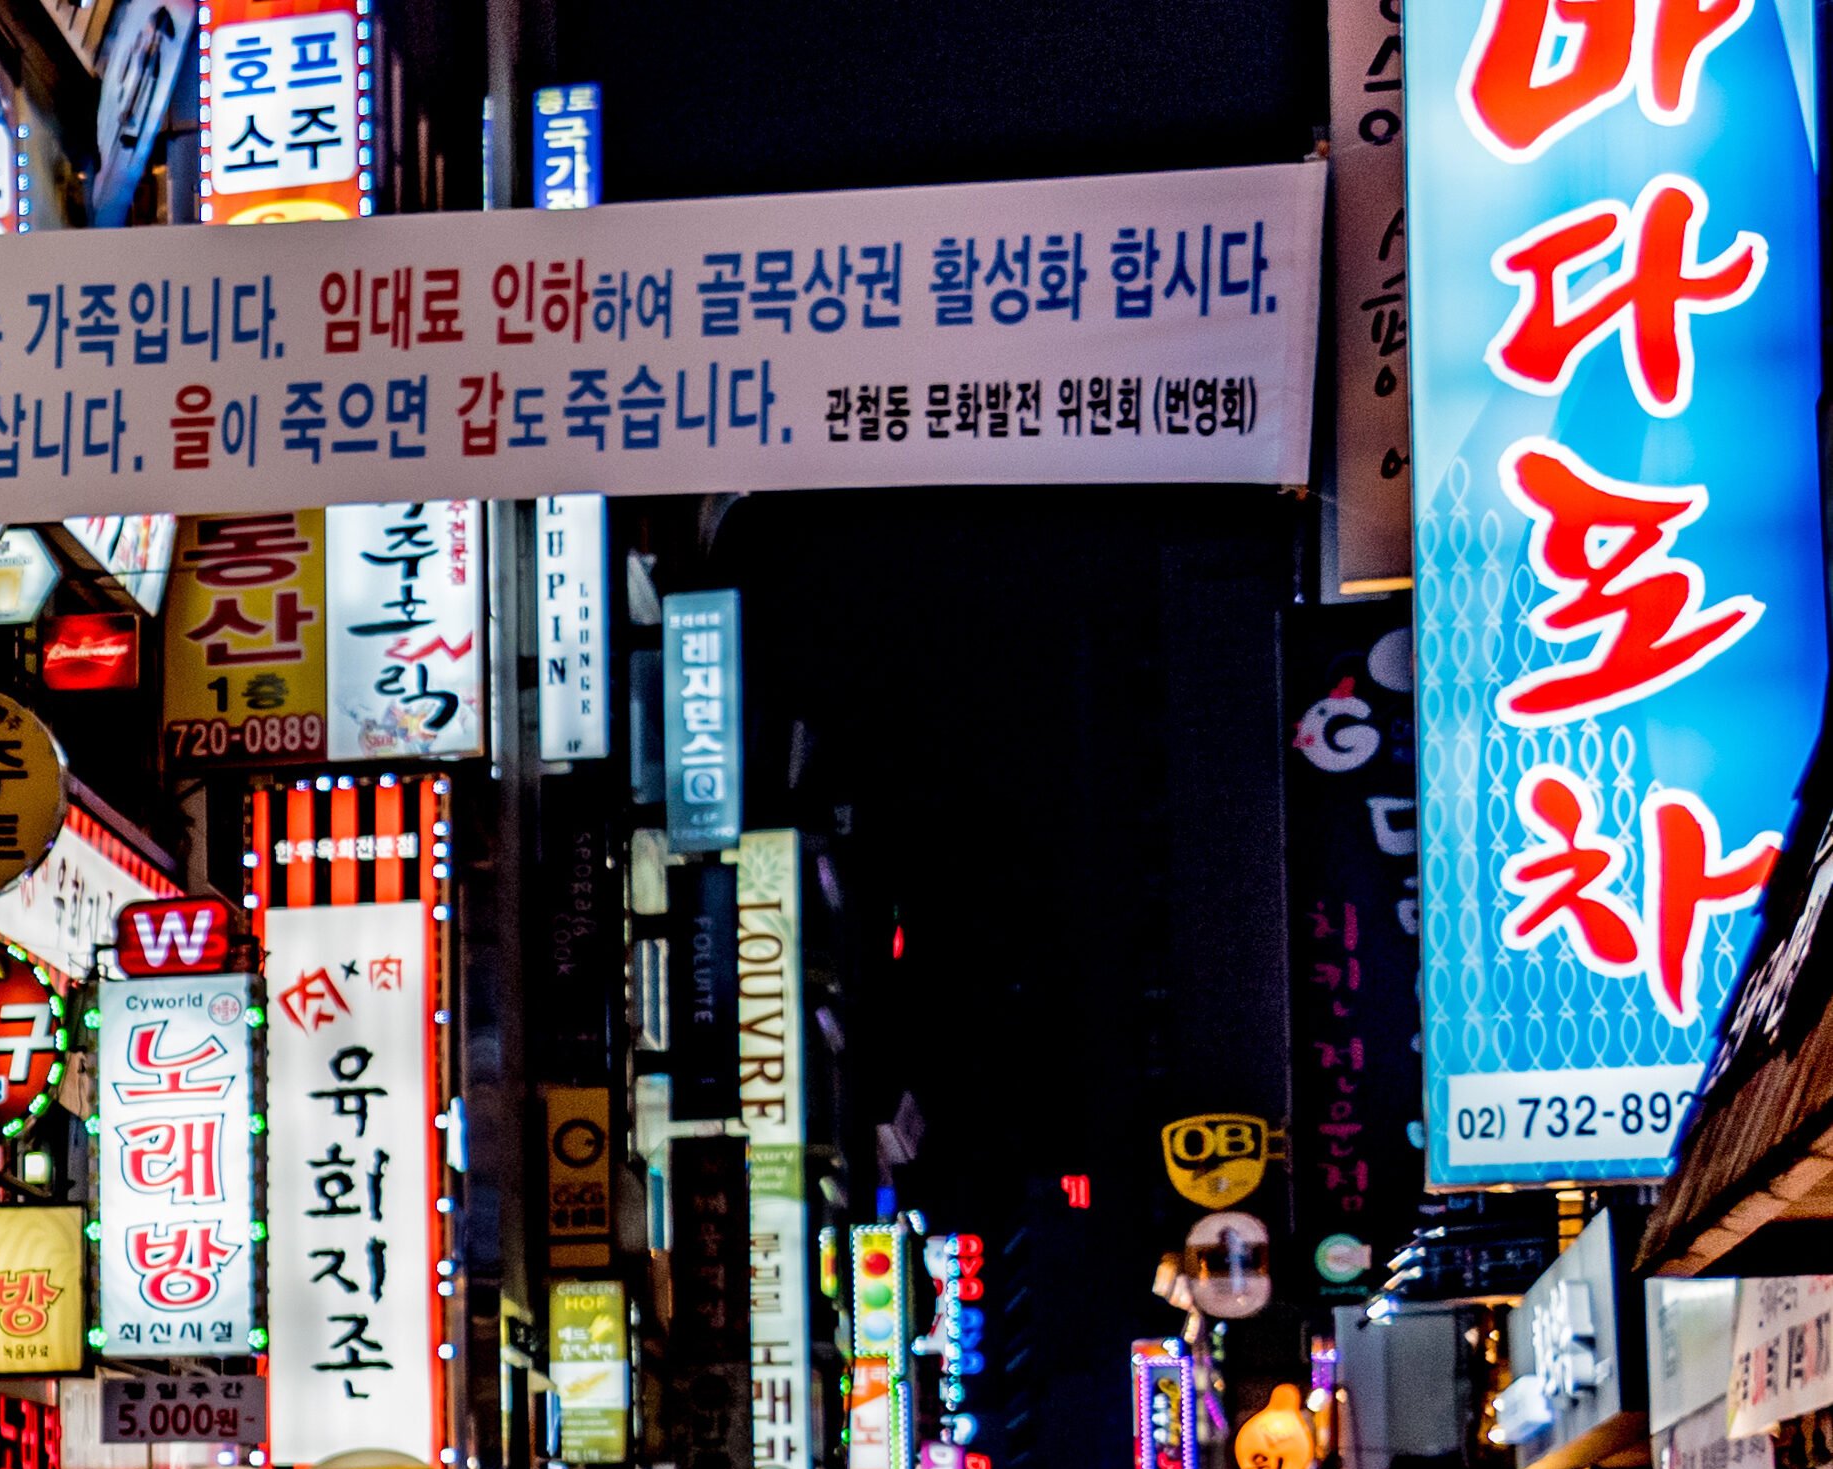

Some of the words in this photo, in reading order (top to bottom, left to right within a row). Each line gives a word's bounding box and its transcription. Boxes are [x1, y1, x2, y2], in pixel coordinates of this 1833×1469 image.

[222, 32, 341, 98] 호프
[224, 105, 342, 176] 소주
[24, 275, 285, 370] 가족입니다.
[320, 267, 465, 354] 임대료
[491, 258, 674, 345] 인하하여
[698, 241, 903, 336] 골목상권
[930, 232, 1088, 327] 활성화
[1111, 221, 1278, 317] 합시다.
[171, 384, 257, 471] 을이
[281, 375, 430, 466] 죽으면
[457, 371, 547, 458] 갑도
[564, 360, 793, 451] 죽습니다.
[826, 384, 910, 442] 관철동
[927, 379, 1043, 440] 문화발전
[1057, 375, 1141, 434] 위원회
[1155, 373, 1259, 436] (번영회)
[171, 715, 322, 758] 720-0889
[274, 830, 420, 865] 한우육회전문점
[133, 910, 210, 968] W
[125, 991, 203, 1013] Cyworld
[738, 897, 788, 1129] LOUVRE
[1173, 1124, 1255, 1160] OB
[1518, 1090, 1695, 1138] 732-89
[111, 1018, 241, 1313] 노래방
[305, 1046, 394, 1399] 육회지존
[118, 1321, 233, 1345] 최신시설
